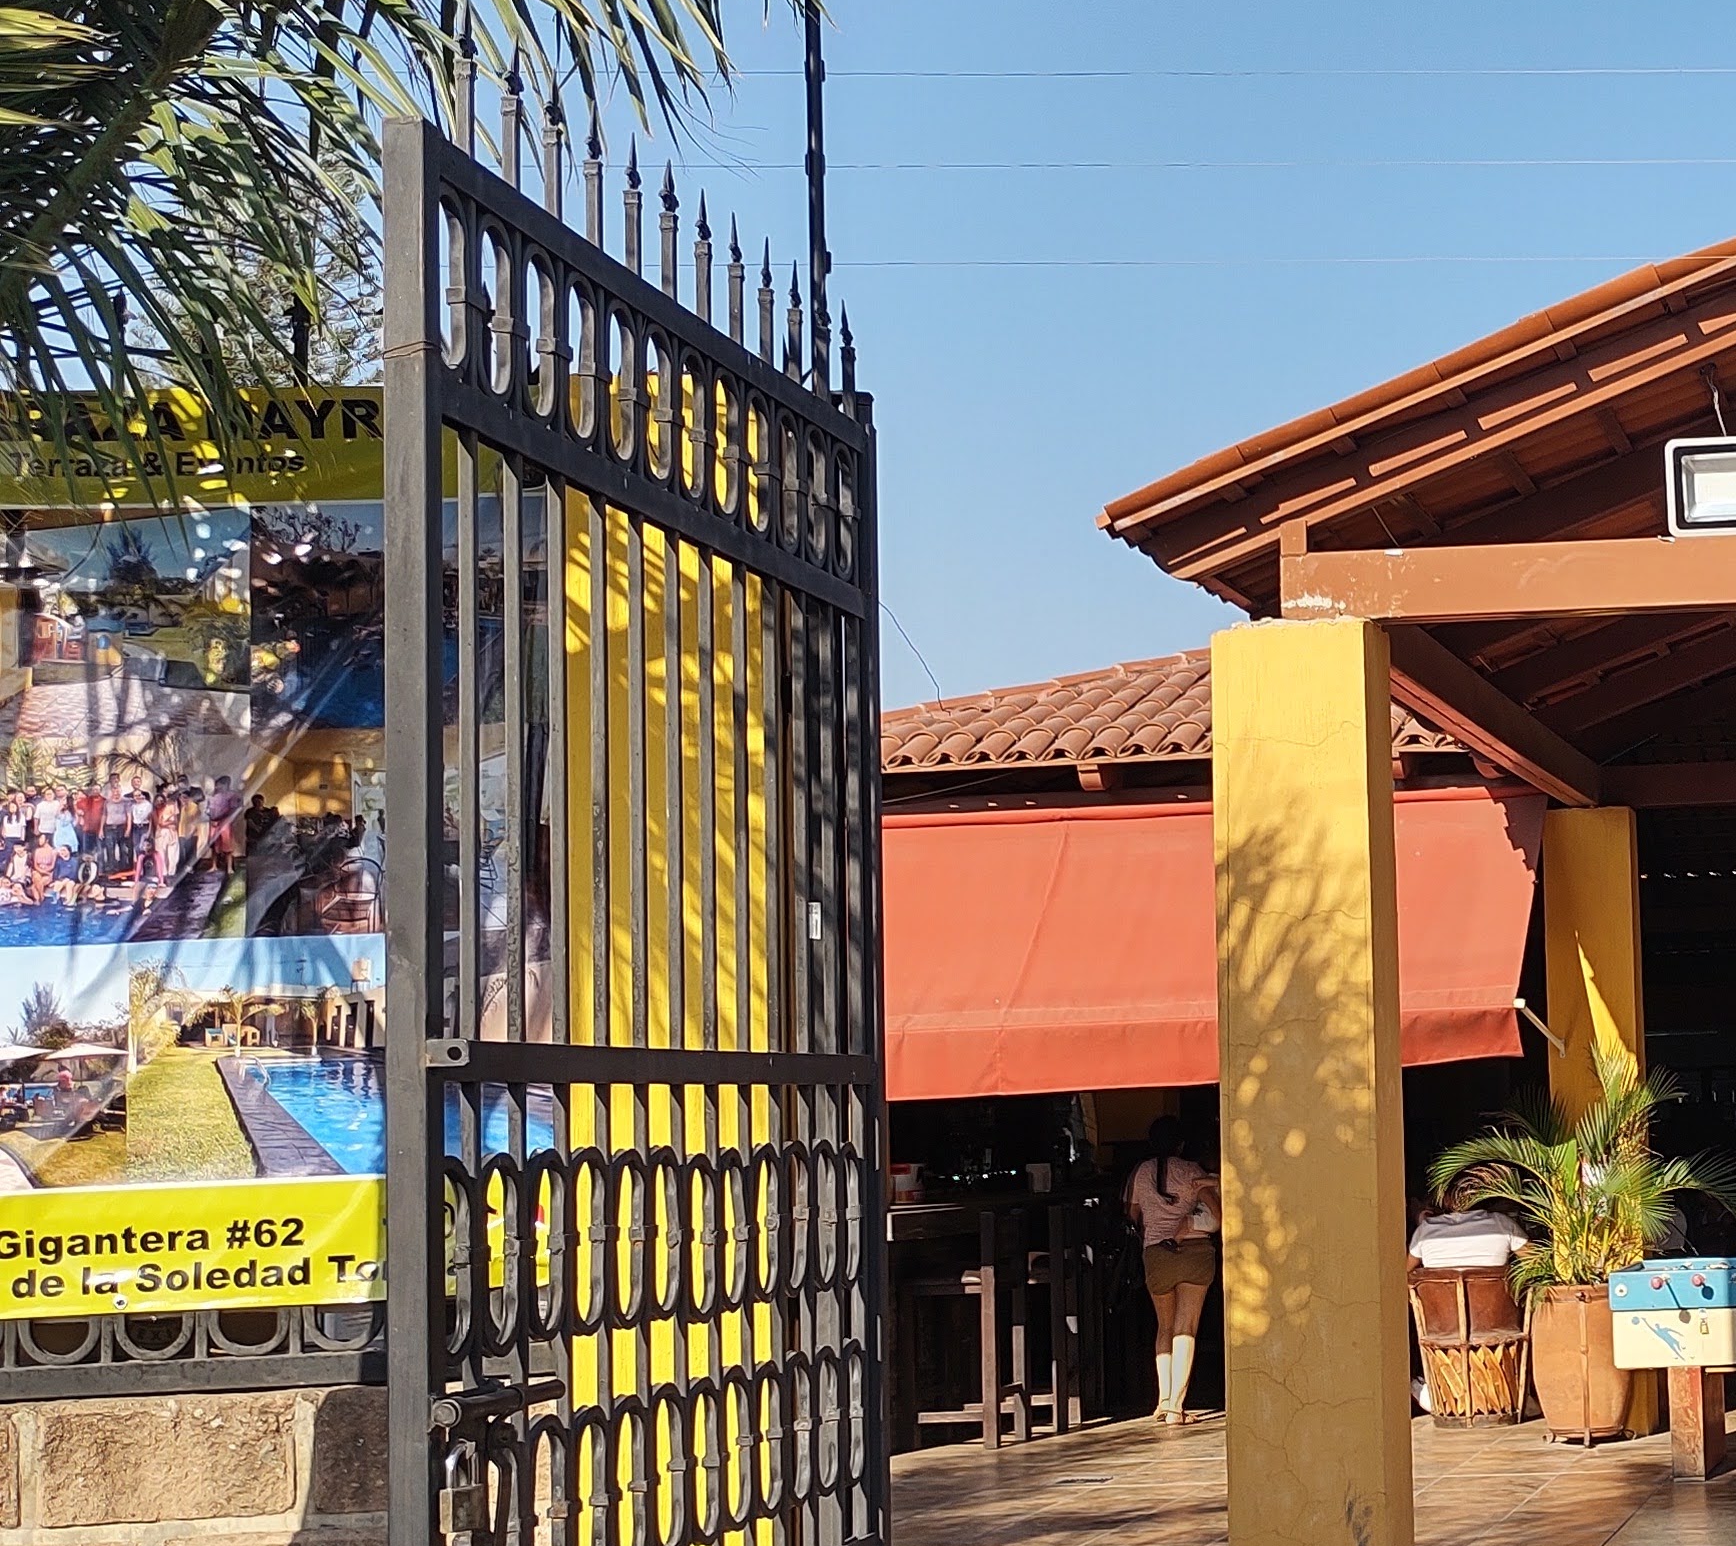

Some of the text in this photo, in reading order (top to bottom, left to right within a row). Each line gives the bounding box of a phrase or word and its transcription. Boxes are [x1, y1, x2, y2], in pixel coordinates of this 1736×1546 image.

[144, 452, 164, 476] &
[177, 452, 305, 476] Evntos
[0, 1218, 305, 1265] Gigantera #62
[12, 1269, 65, 1298] de
[82, 1267, 119, 1295] la
[136, 1257, 311, 1292] Soledad
